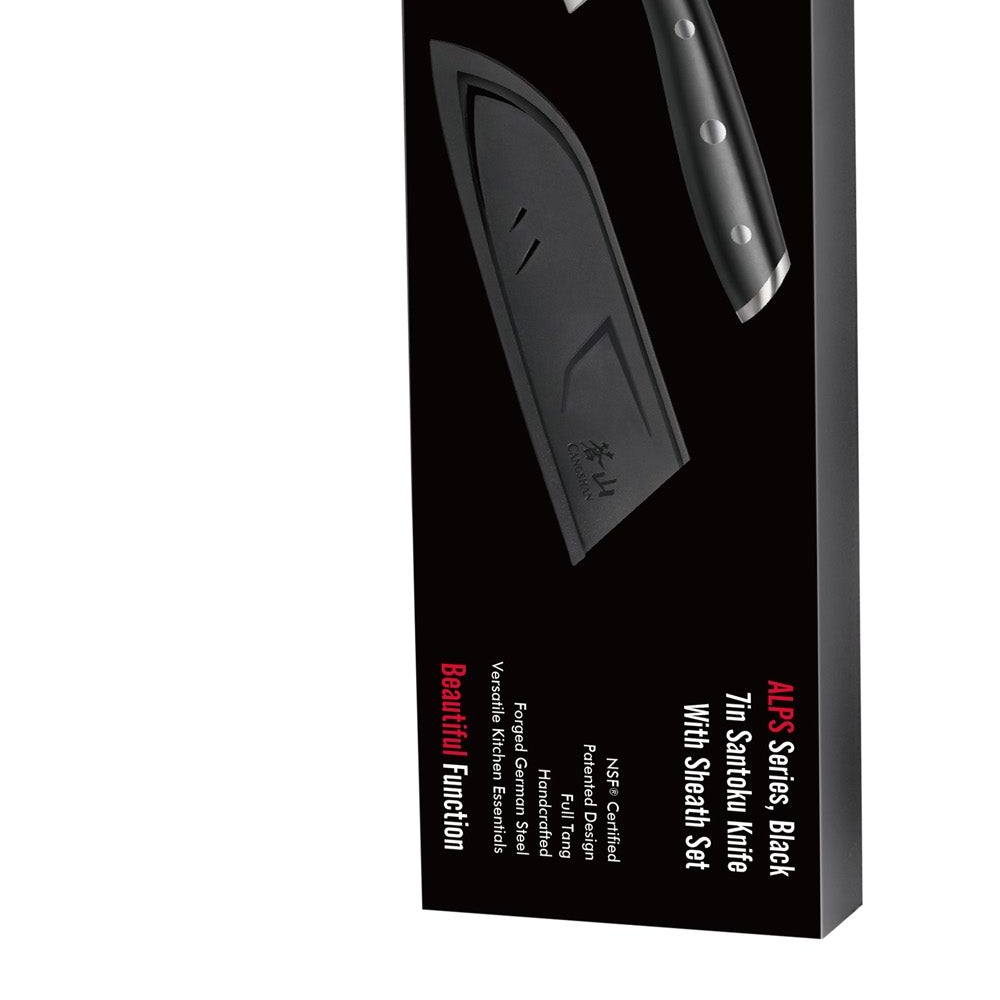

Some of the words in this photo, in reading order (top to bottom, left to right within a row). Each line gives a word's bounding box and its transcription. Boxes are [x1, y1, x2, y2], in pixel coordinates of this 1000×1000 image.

[441, 663, 468, 756] Beautiful
[491, 661, 505, 723] Versatile
[725, 692, 752, 722] 7in
[767, 680, 795, 733] ALPS
[492, 728, 506, 780] Kitchen
[511, 702, 528, 752] Forged
[684, 703, 710, 749] With
[515, 757, 528, 816] German
[583, 744, 597, 807] Patented
[684, 756, 711, 828] Sheath
[726, 729, 753, 813] Santoku
[764, 740, 795, 811] Series,
[442, 763, 469, 851] Function
[493, 786, 507, 854] Essentials
[538, 769, 552, 857] Handcrafted
[560, 793, 575, 819] Full
[606, 801, 621, 863] Certified
[516, 821, 529, 855] Steel
[559, 824, 575, 859] Tang
[581, 812, 597, 861] Design
[685, 835, 712, 870] Set
[727, 820, 753, 873] Knife
[769, 820, 795, 877] Black
